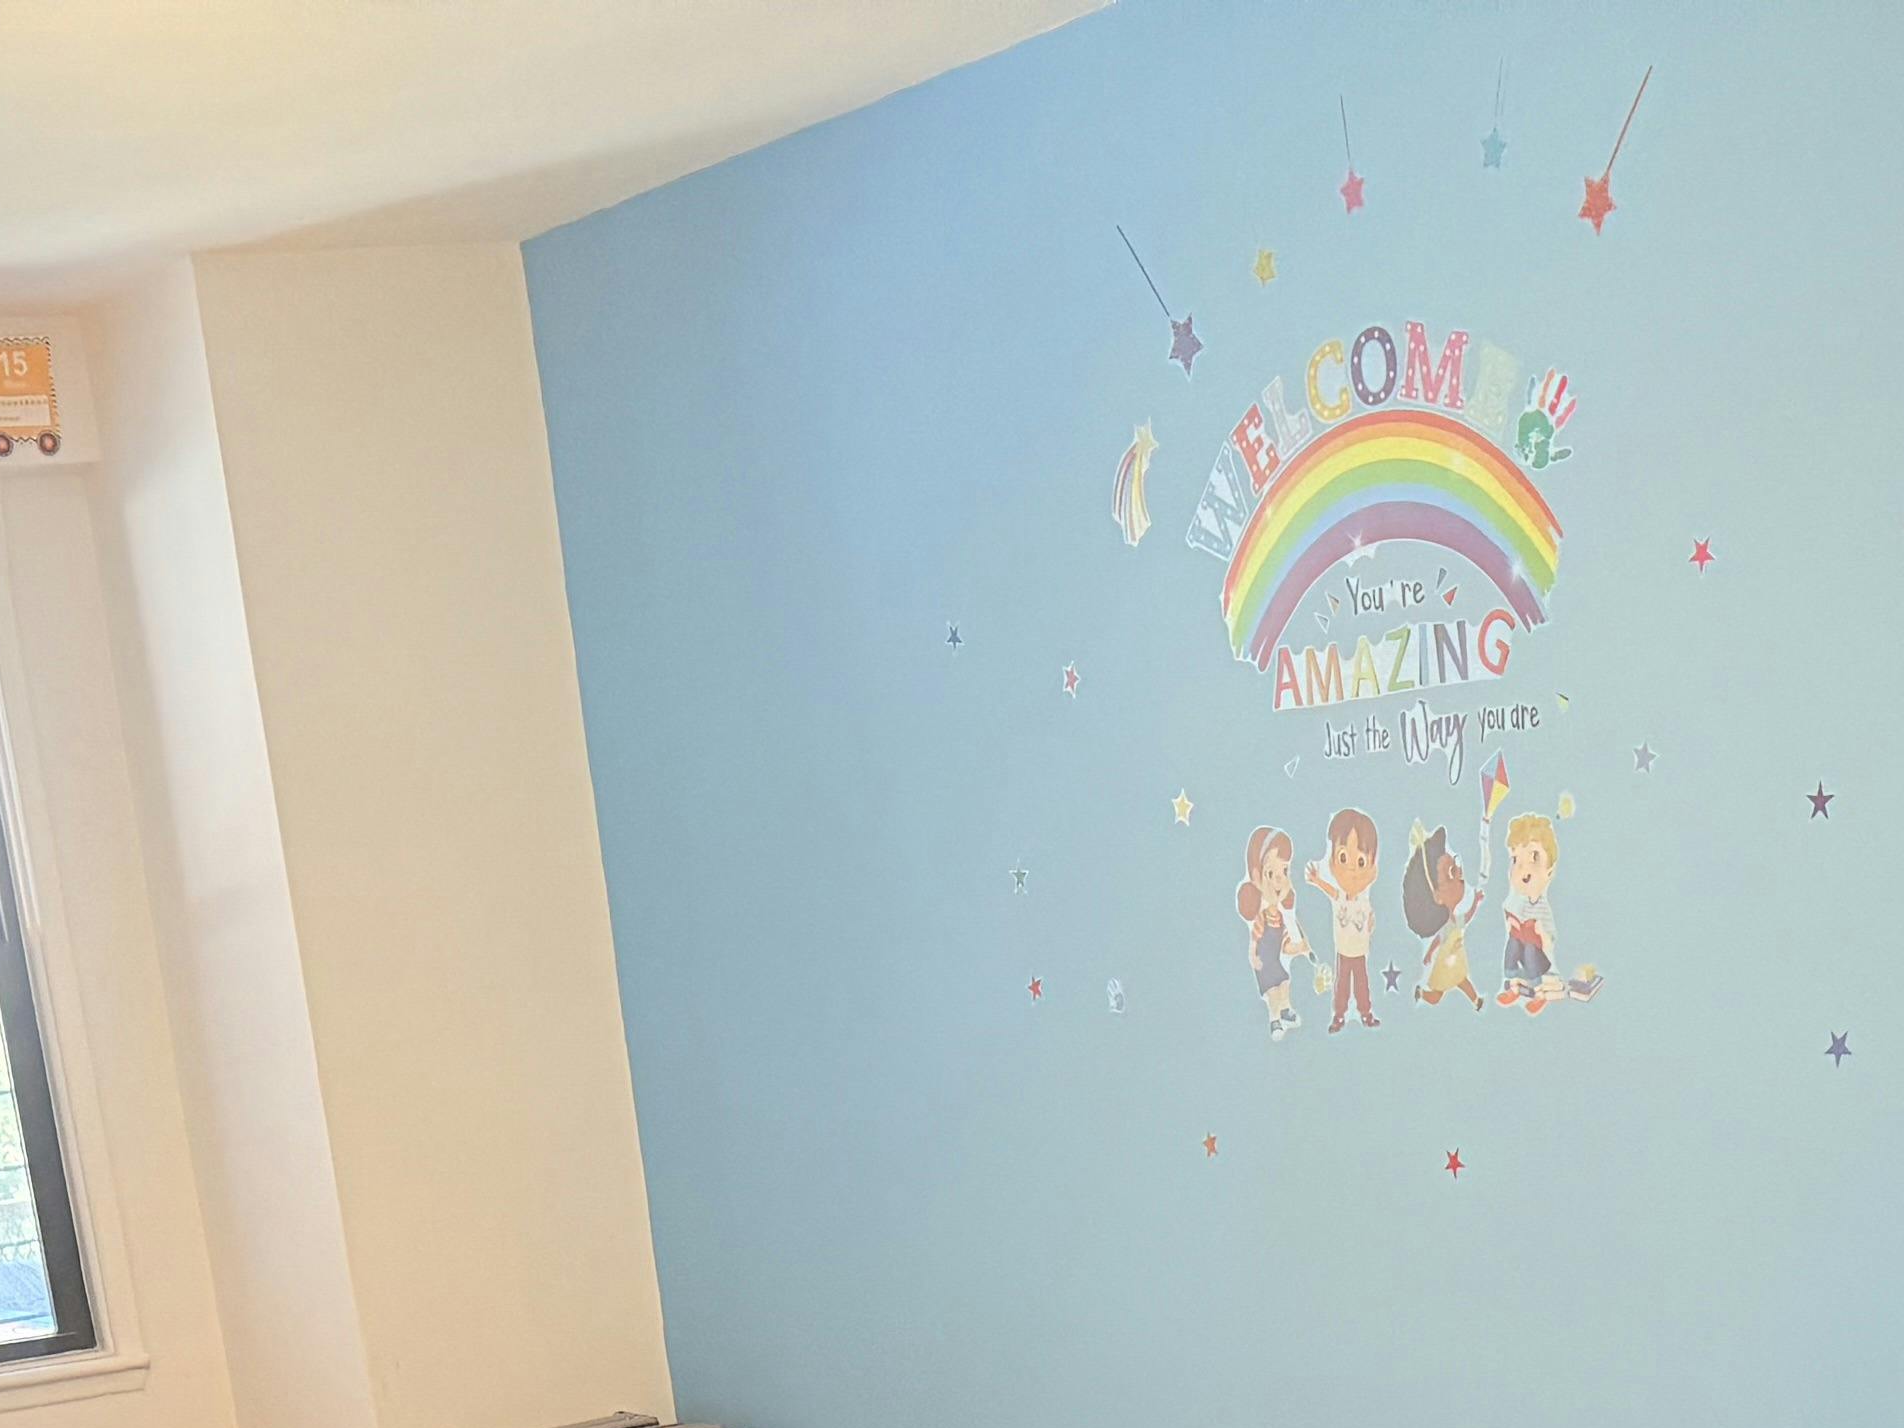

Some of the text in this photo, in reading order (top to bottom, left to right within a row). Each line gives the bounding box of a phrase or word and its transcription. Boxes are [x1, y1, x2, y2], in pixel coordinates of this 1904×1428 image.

[1345, 577, 1426, 617] You're
[1274, 608, 1517, 710] AMAZING
[1324, 699, 1540, 786] Just the Way you are
